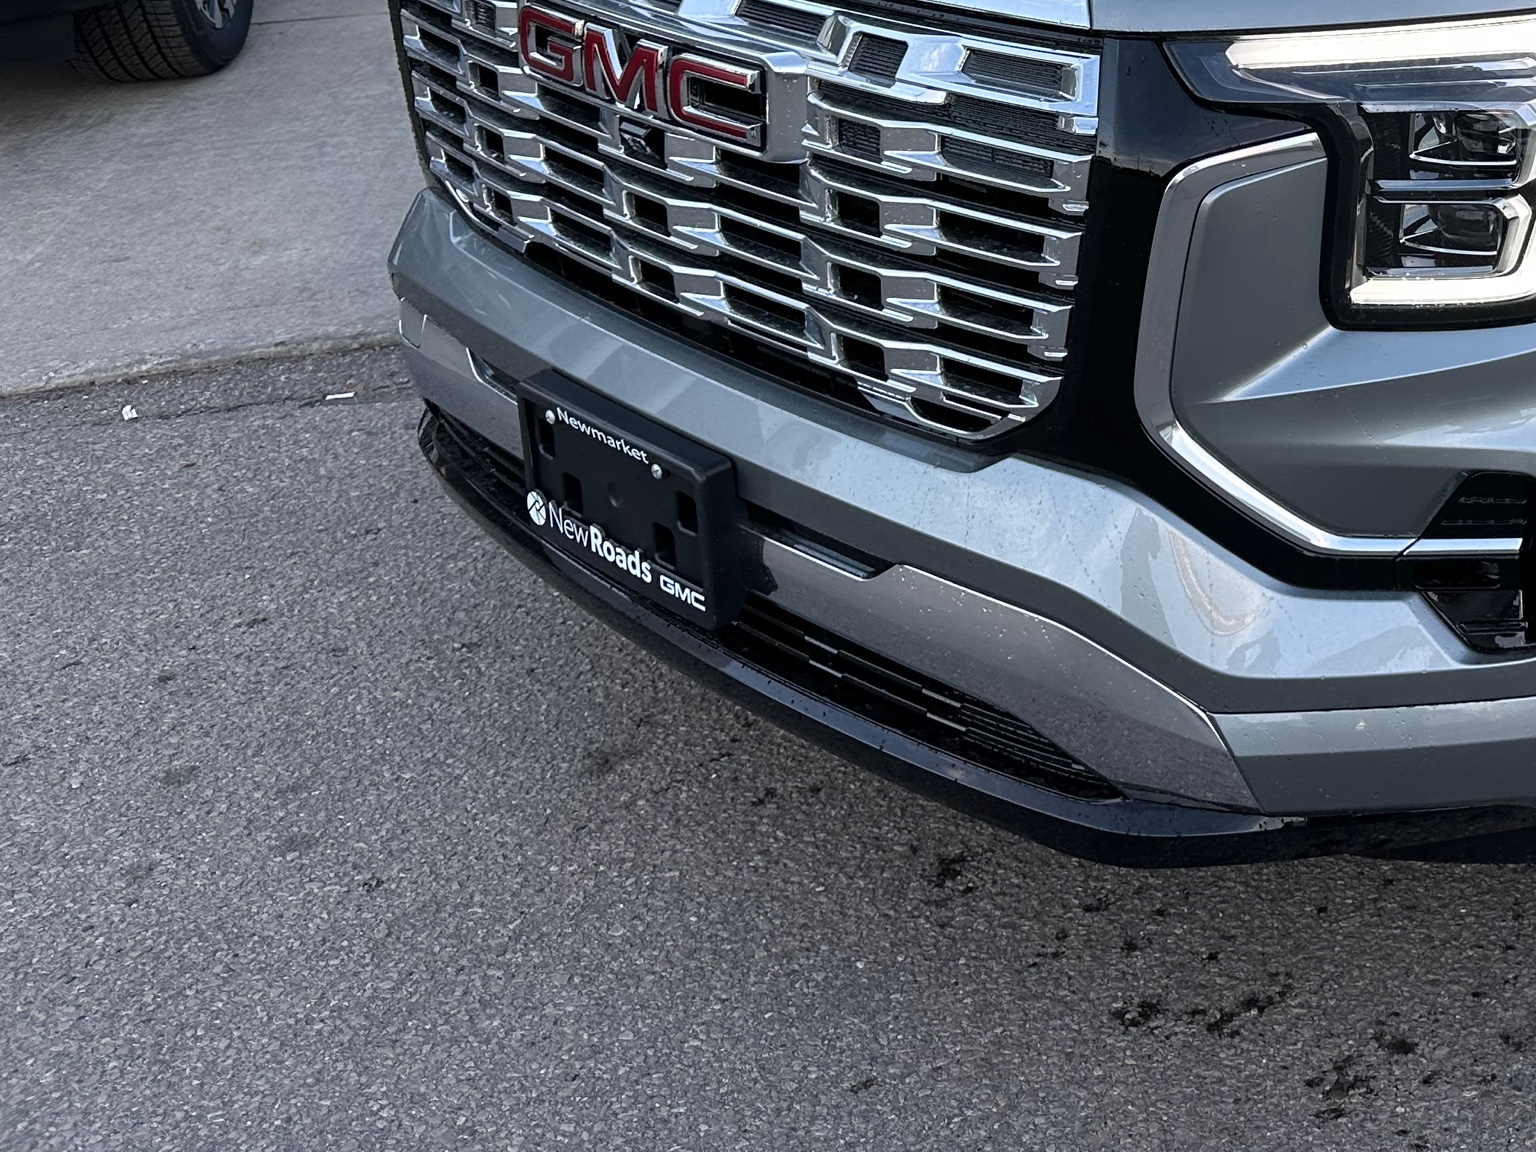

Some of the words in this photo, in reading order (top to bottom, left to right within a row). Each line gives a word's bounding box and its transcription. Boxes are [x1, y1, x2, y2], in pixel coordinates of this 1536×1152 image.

[518, 3, 763, 148] GMC
[556, 406, 650, 465] Newmarket
[659, 574, 706, 612] GMC
